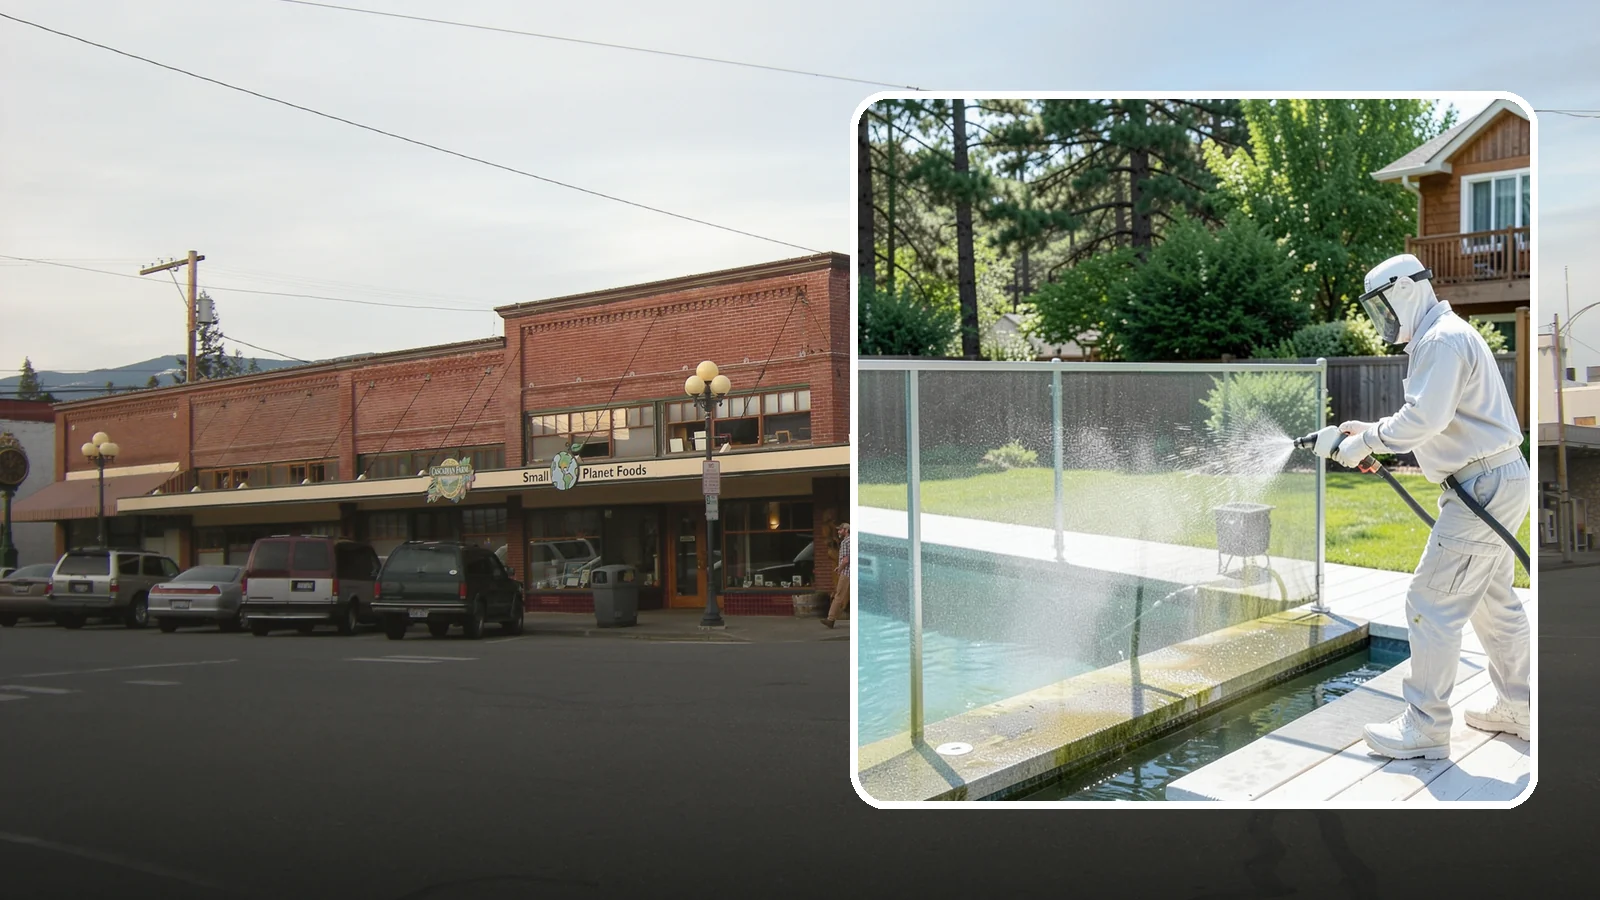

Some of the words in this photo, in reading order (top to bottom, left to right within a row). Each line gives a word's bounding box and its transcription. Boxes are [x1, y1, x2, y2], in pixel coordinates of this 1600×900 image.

[523, 471, 549, 483] Small
[583, 467, 614, 479] Planet
[617, 464, 647, 477] Foods
